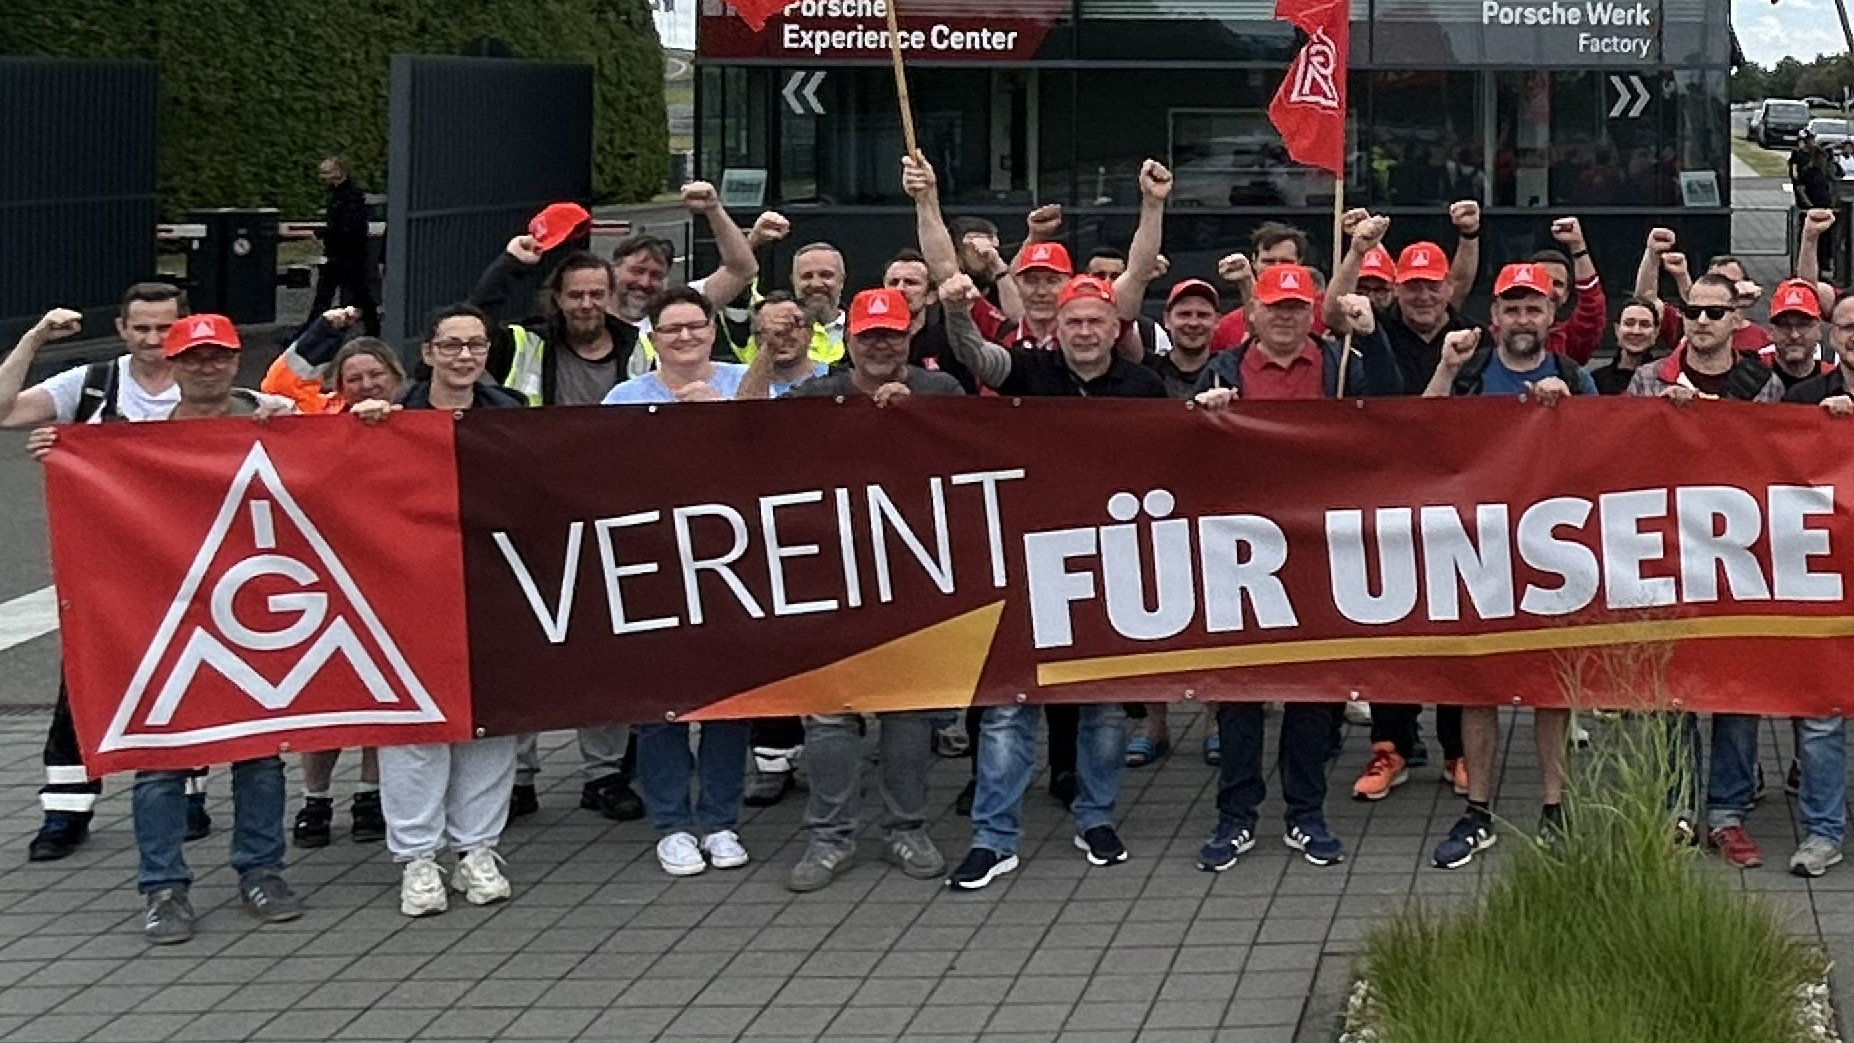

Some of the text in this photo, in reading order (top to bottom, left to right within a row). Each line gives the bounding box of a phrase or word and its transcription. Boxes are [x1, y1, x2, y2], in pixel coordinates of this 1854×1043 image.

[1482, 0, 1652, 26] Porsche Werk
[783, 23, 1018, 55] Experience Center
[1578, 32, 1652, 59] Factory
[492, 468, 1025, 644] VEREINT
[1024, 489, 1299, 649] FÜR
[1325, 485, 1844, 625] UNSERE
